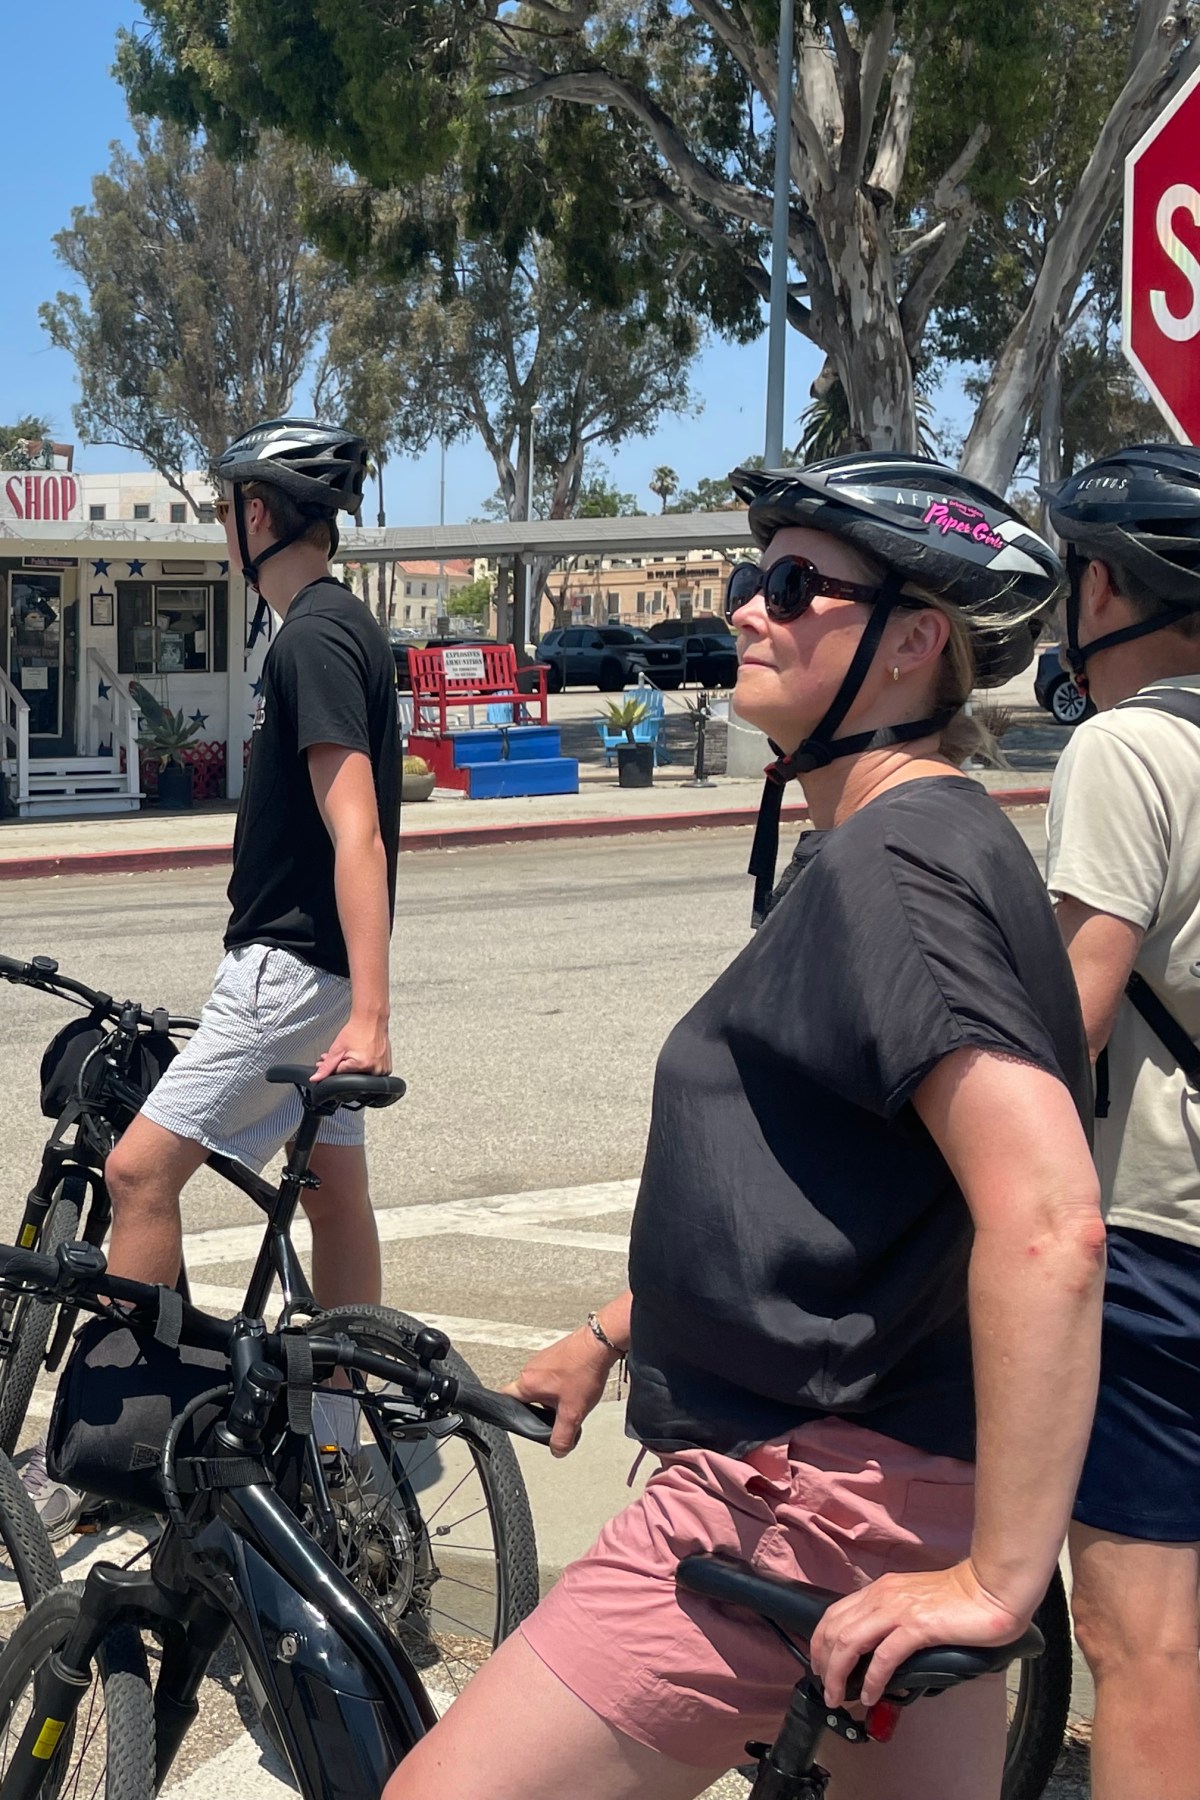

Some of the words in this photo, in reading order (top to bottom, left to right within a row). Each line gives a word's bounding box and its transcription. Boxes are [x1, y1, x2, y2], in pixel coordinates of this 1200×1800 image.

[6, 475, 77, 520] SHOP
[923, 502, 972, 535] Paper
[972, 523, 1005, 550] Girls
